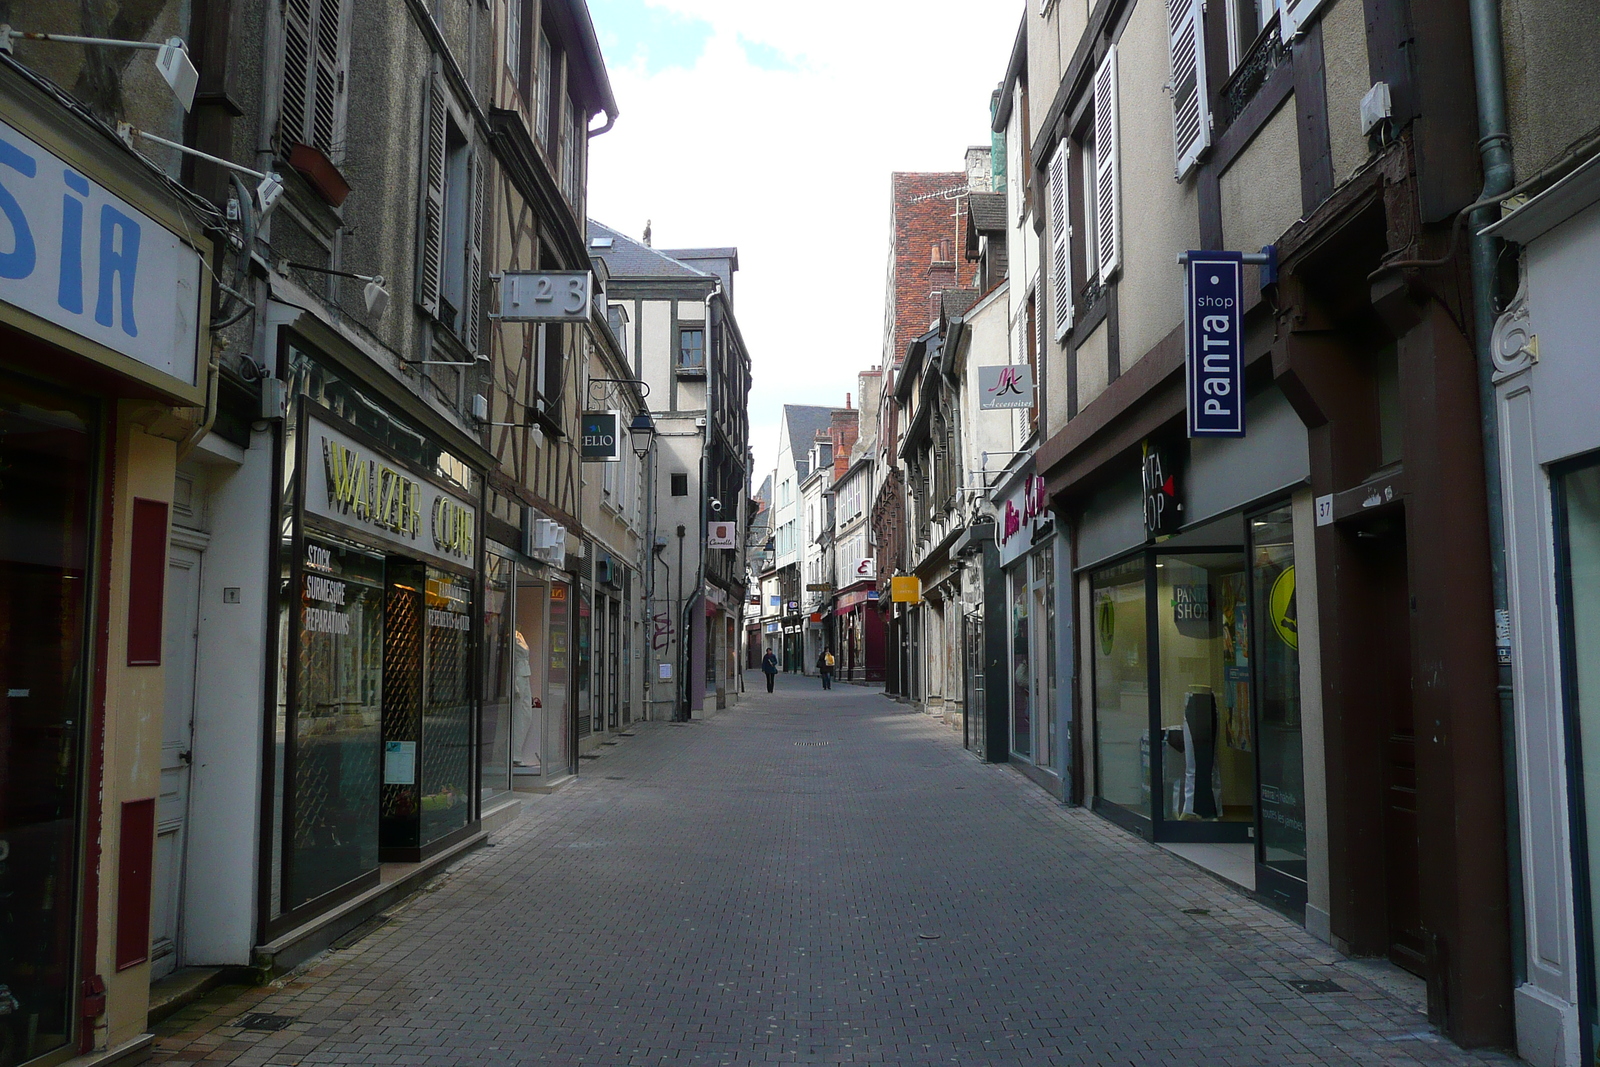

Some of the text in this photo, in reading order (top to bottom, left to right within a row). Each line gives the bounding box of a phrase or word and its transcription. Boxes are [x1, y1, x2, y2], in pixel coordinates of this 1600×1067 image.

[1197, 295, 1234, 308] shop
[982, 398, 1033, 408] Accessoires
[1318, 501, 1331, 518] 37
[307, 544, 331, 573] STOCK
